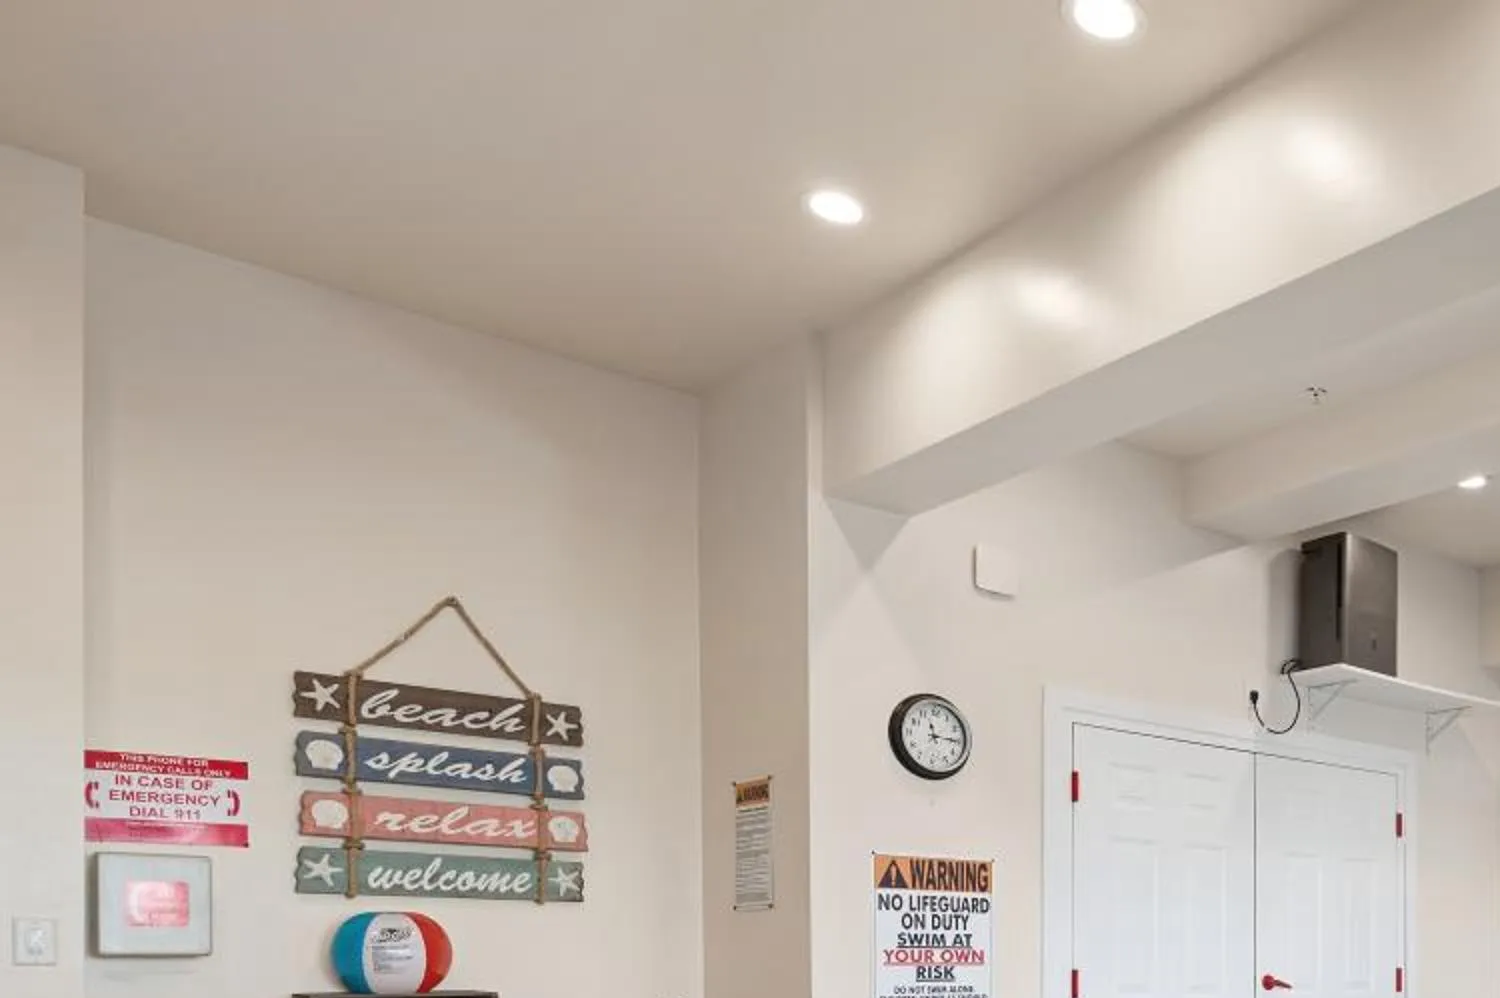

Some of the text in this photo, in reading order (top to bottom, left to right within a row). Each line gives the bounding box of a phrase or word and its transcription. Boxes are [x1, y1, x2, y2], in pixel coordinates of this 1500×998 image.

[361, 688, 526, 732] beach
[95, 761, 164, 773] EMERGENCY
[364, 751, 528, 783] splash
[115, 774, 214, 791] IN CASE OF
[108, 789, 221, 807] EMERGENCY
[129, 806, 202, 821] DIAL 911
[374, 805, 536, 839] relax
[367, 857, 533, 893] welcome
[909, 859, 989, 893] WARNING
[877, 894, 991, 914] NO LIFEGUARD
[901, 913, 969, 931] ON DUTY
[897, 932, 973, 947] SWIM AT
[883, 949, 985, 964] YOUR OWN
[916, 965, 955, 980] RISK
